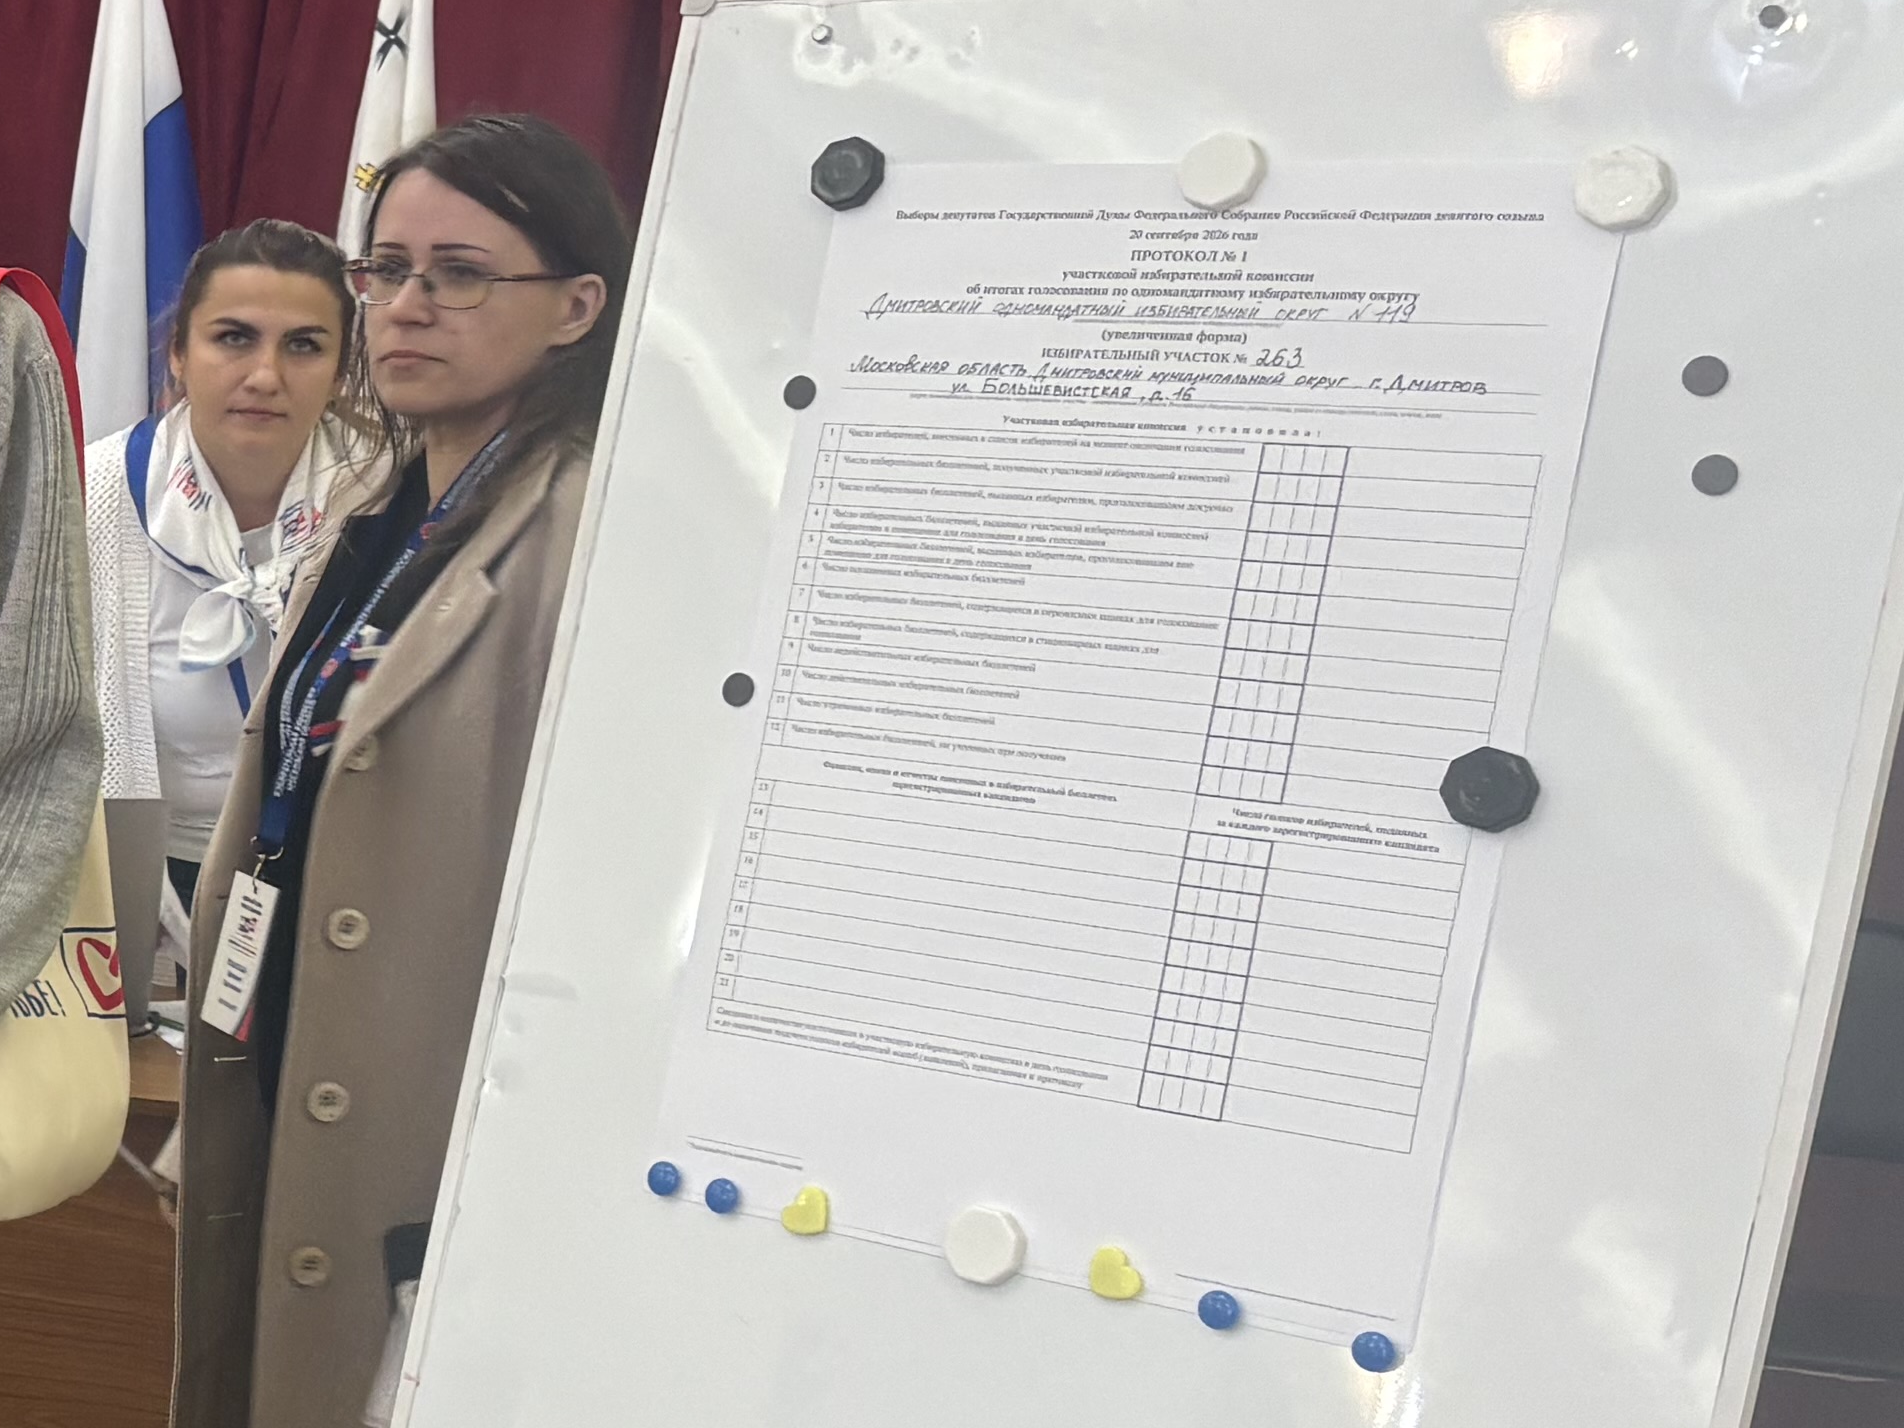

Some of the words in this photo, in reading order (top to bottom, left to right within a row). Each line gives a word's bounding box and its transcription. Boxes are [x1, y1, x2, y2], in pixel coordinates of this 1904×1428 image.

[1130, 249, 1218, 261] ПРОТОКОЛ
[1220, 250, 1236, 262] №
[1061, 268, 1135, 280] участковой
[1139, 269, 1242, 281] избирательной
[966, 283, 980, 296] об
[983, 286, 1024, 294] итогах
[1028, 286, 1108, 295] голосования
[1111, 287, 1128, 296] по
[1249, 288, 1365, 301] избирательному
[1041, 348, 1160, 360] ИЗБИРАТЕЛЬНЫЙ
[1164, 351, 1230, 362] УЧАСТОК
[1255, 347, 1303, 368] 263
